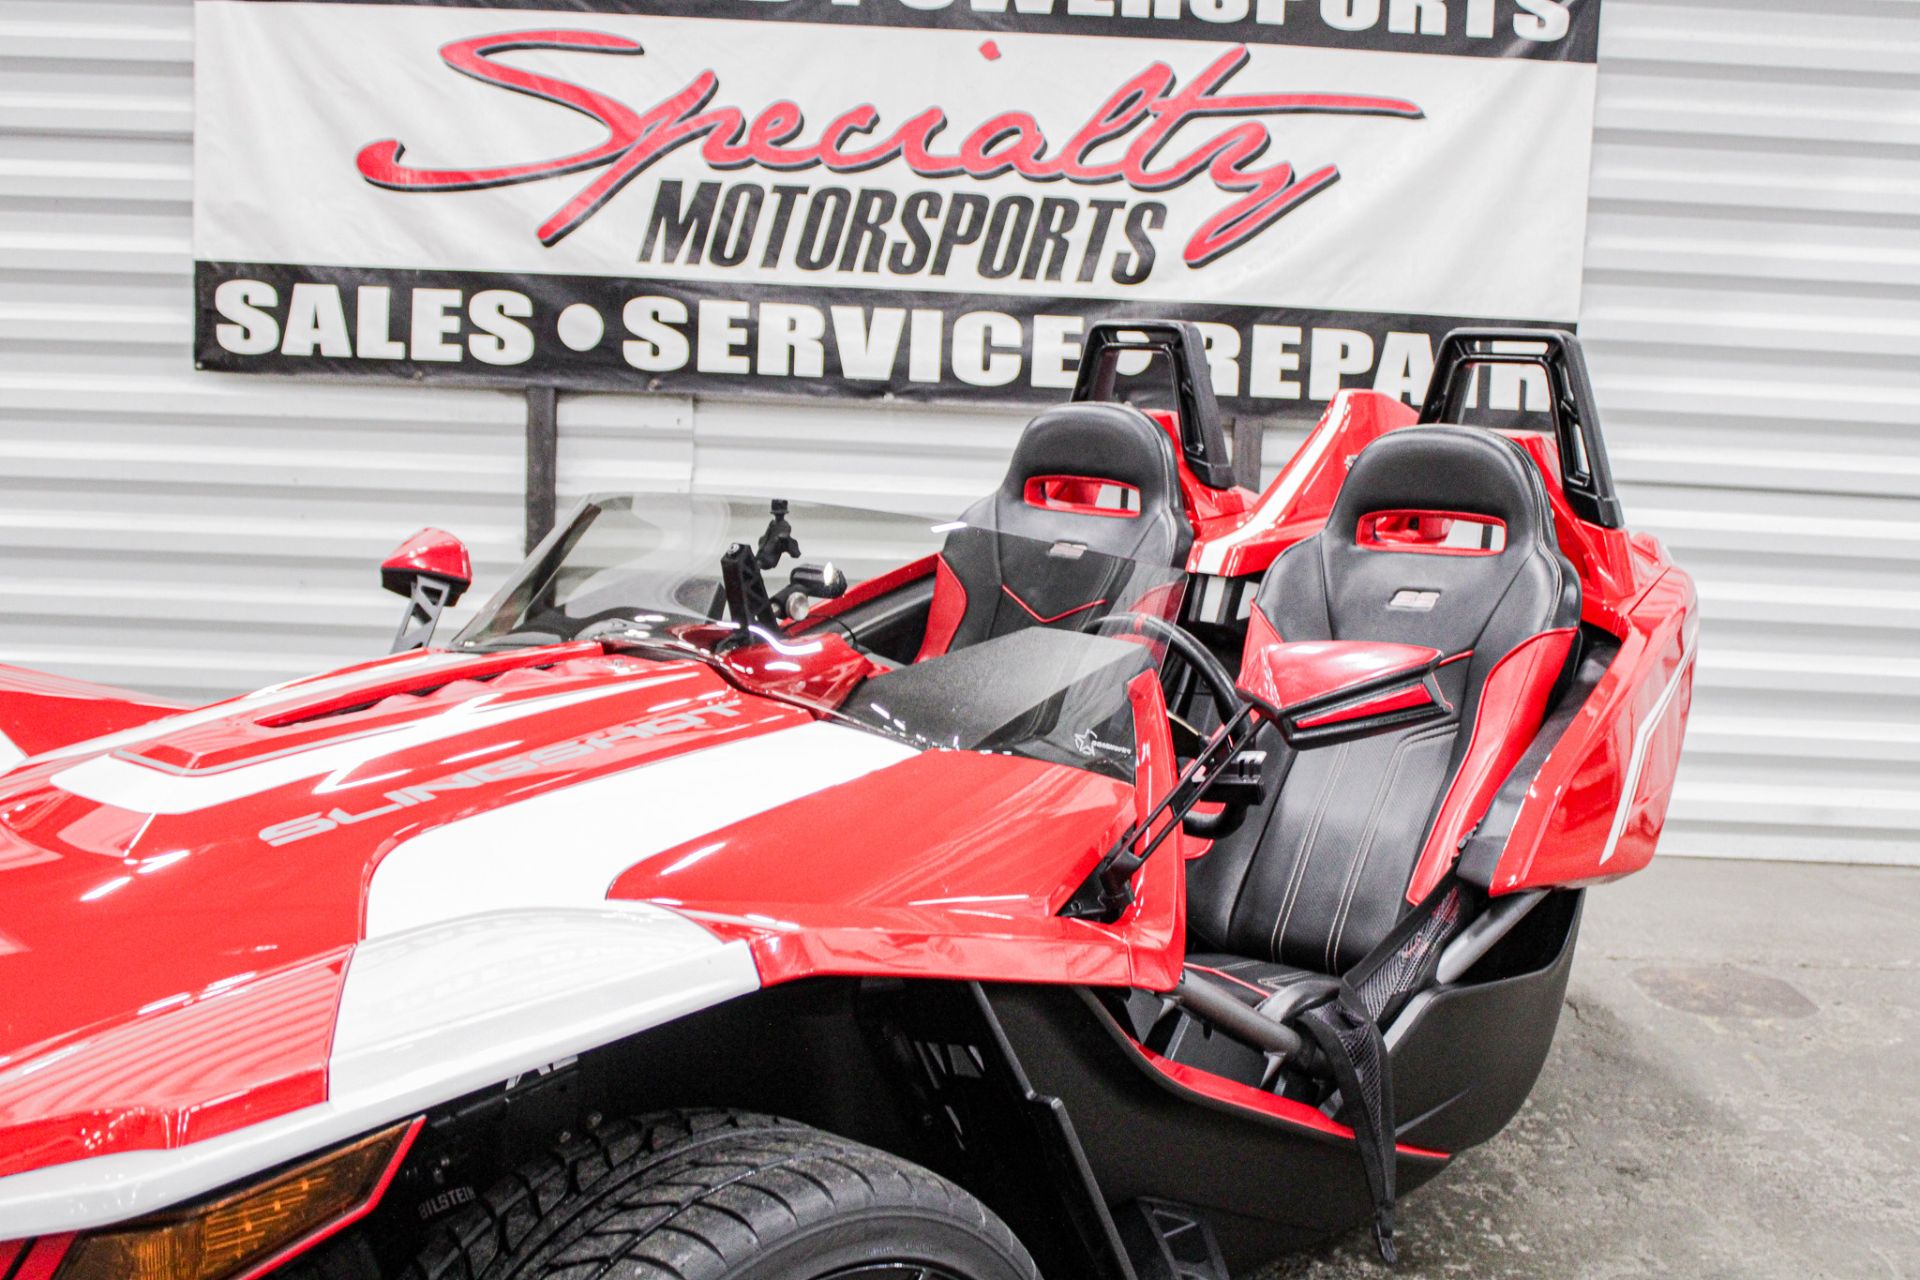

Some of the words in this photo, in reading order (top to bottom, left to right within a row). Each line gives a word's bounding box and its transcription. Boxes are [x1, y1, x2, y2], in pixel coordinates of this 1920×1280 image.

[356, 29, 1425, 268] Specialty
[639, 179, 1167, 285] MOTORSPORTS
[214, 279, 535, 366] SALES
[622, 296, 1084, 388] SERVICE
[1202, 321, 1551, 413] REPAR
[258, 703, 744, 847] SLINGSHOT
